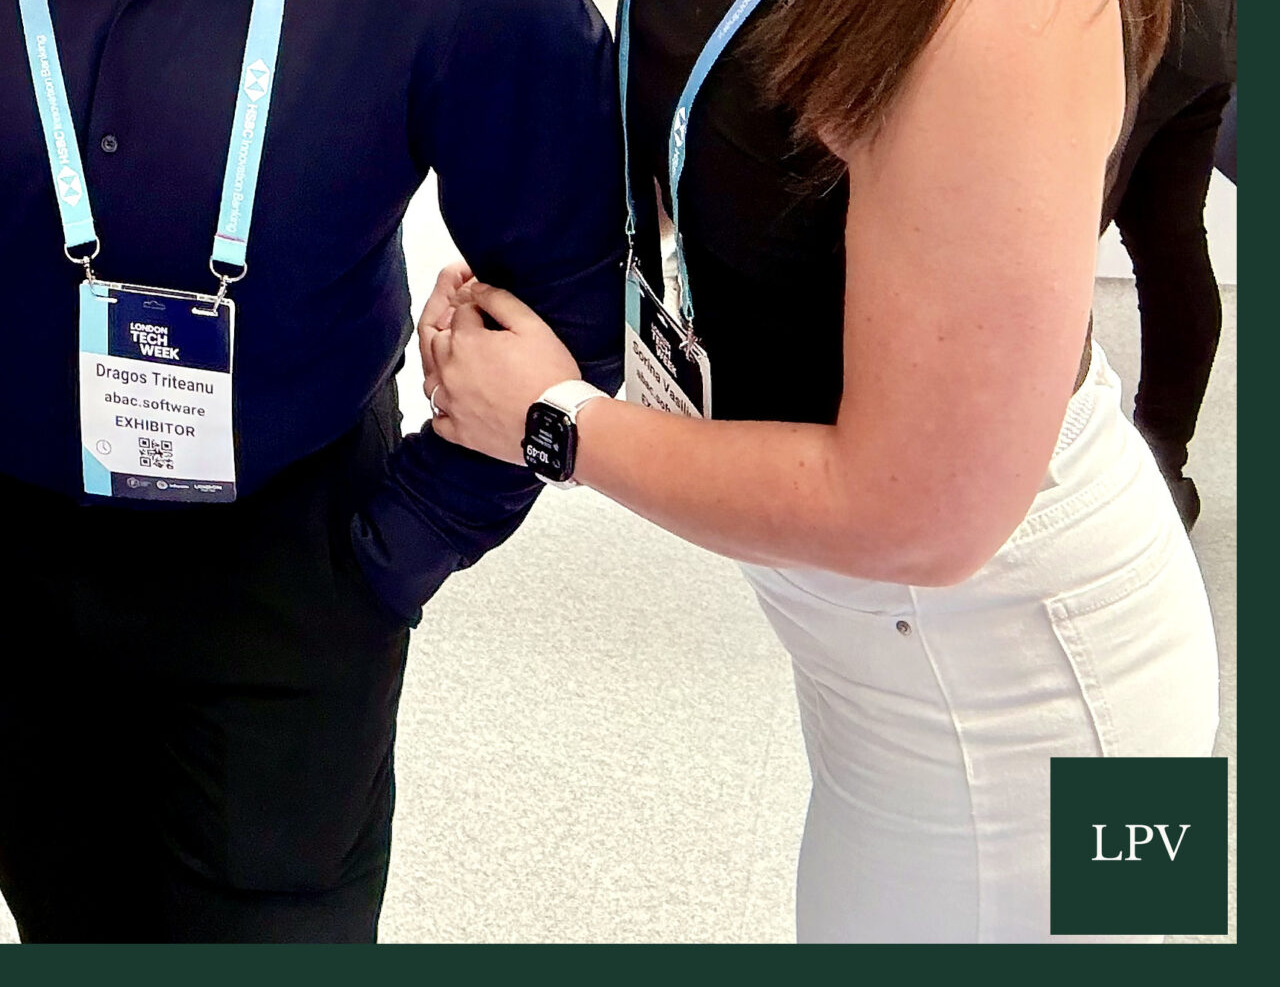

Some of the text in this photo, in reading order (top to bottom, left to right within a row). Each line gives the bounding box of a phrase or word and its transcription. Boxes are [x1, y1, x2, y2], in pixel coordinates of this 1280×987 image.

[242, 103, 258, 139] HSBC
[130, 322, 169, 335] LONDON
[130, 330, 169, 347] TECH
[139, 343, 180, 361] WEEK
[96, 363, 215, 395] Dragos Triteanu
[104, 391, 206, 417] abac.software
[115, 415, 196, 438] EXHIBITOR
